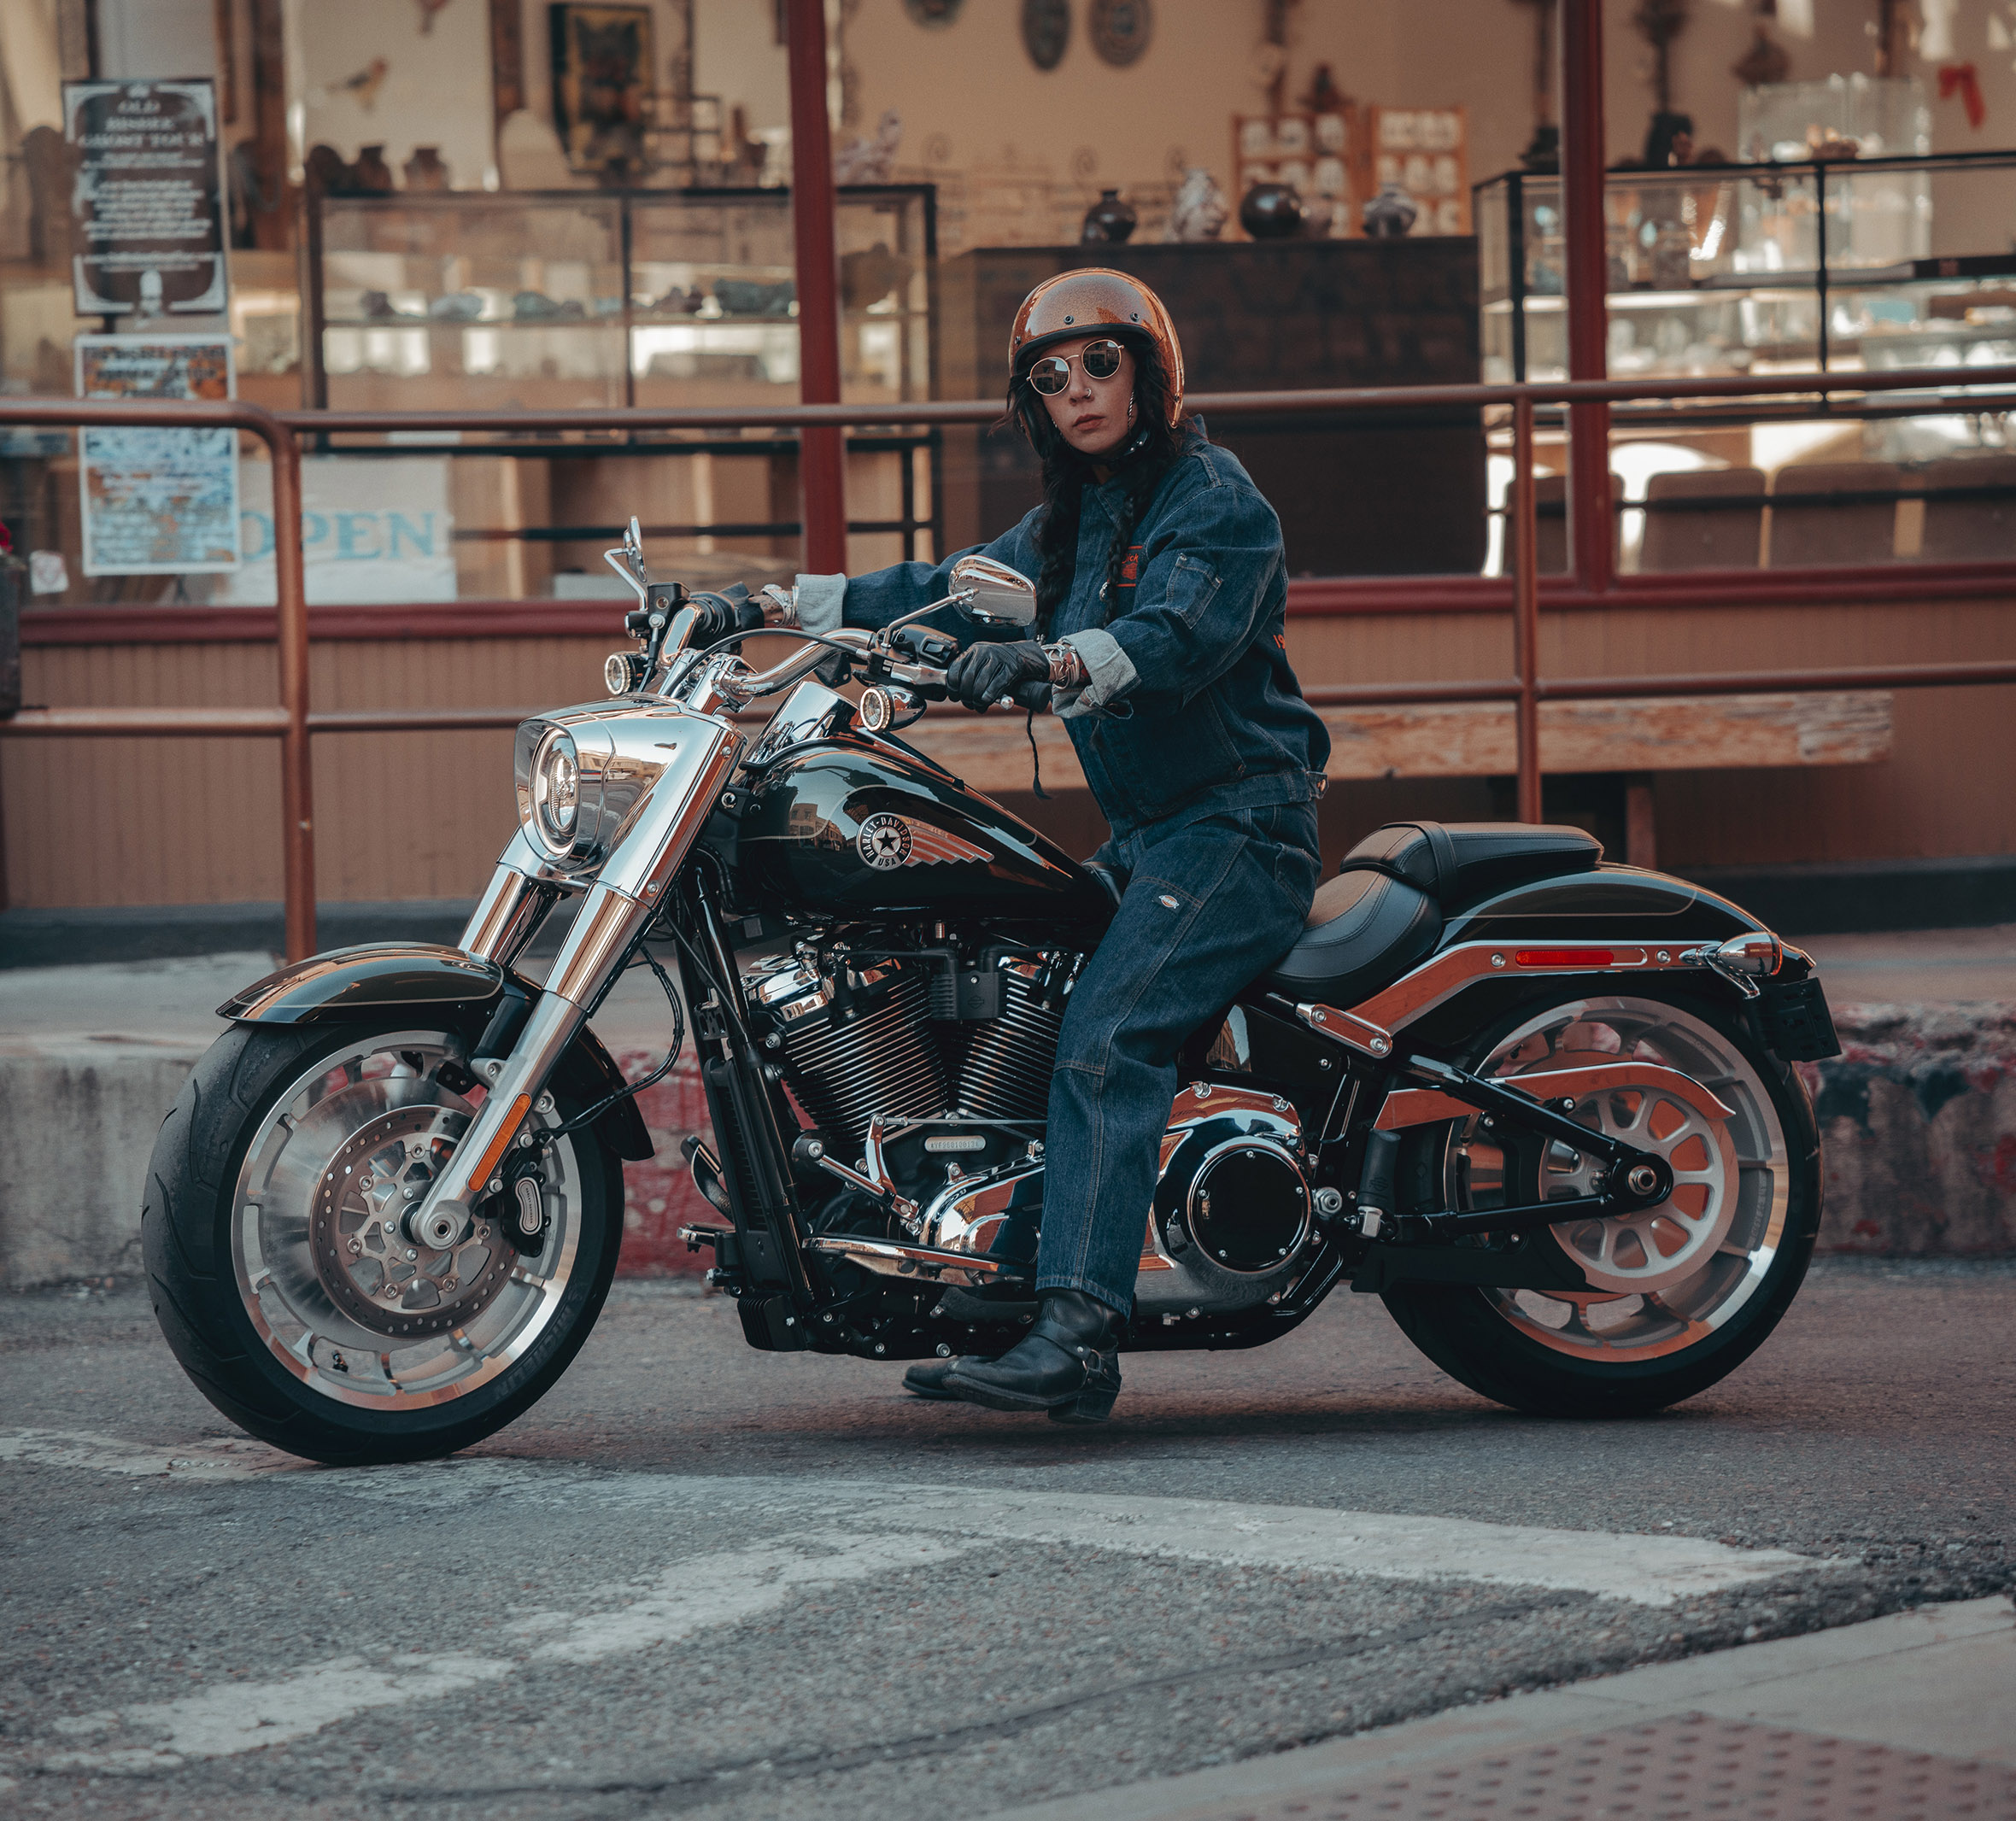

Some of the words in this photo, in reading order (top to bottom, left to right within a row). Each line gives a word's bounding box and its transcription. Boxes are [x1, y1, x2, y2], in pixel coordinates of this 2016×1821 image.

[240, 510, 437, 561] OPEN
[861, 816, 911, 858] HARLEY-DAVIDSON
[878, 858, 897, 867] USA
